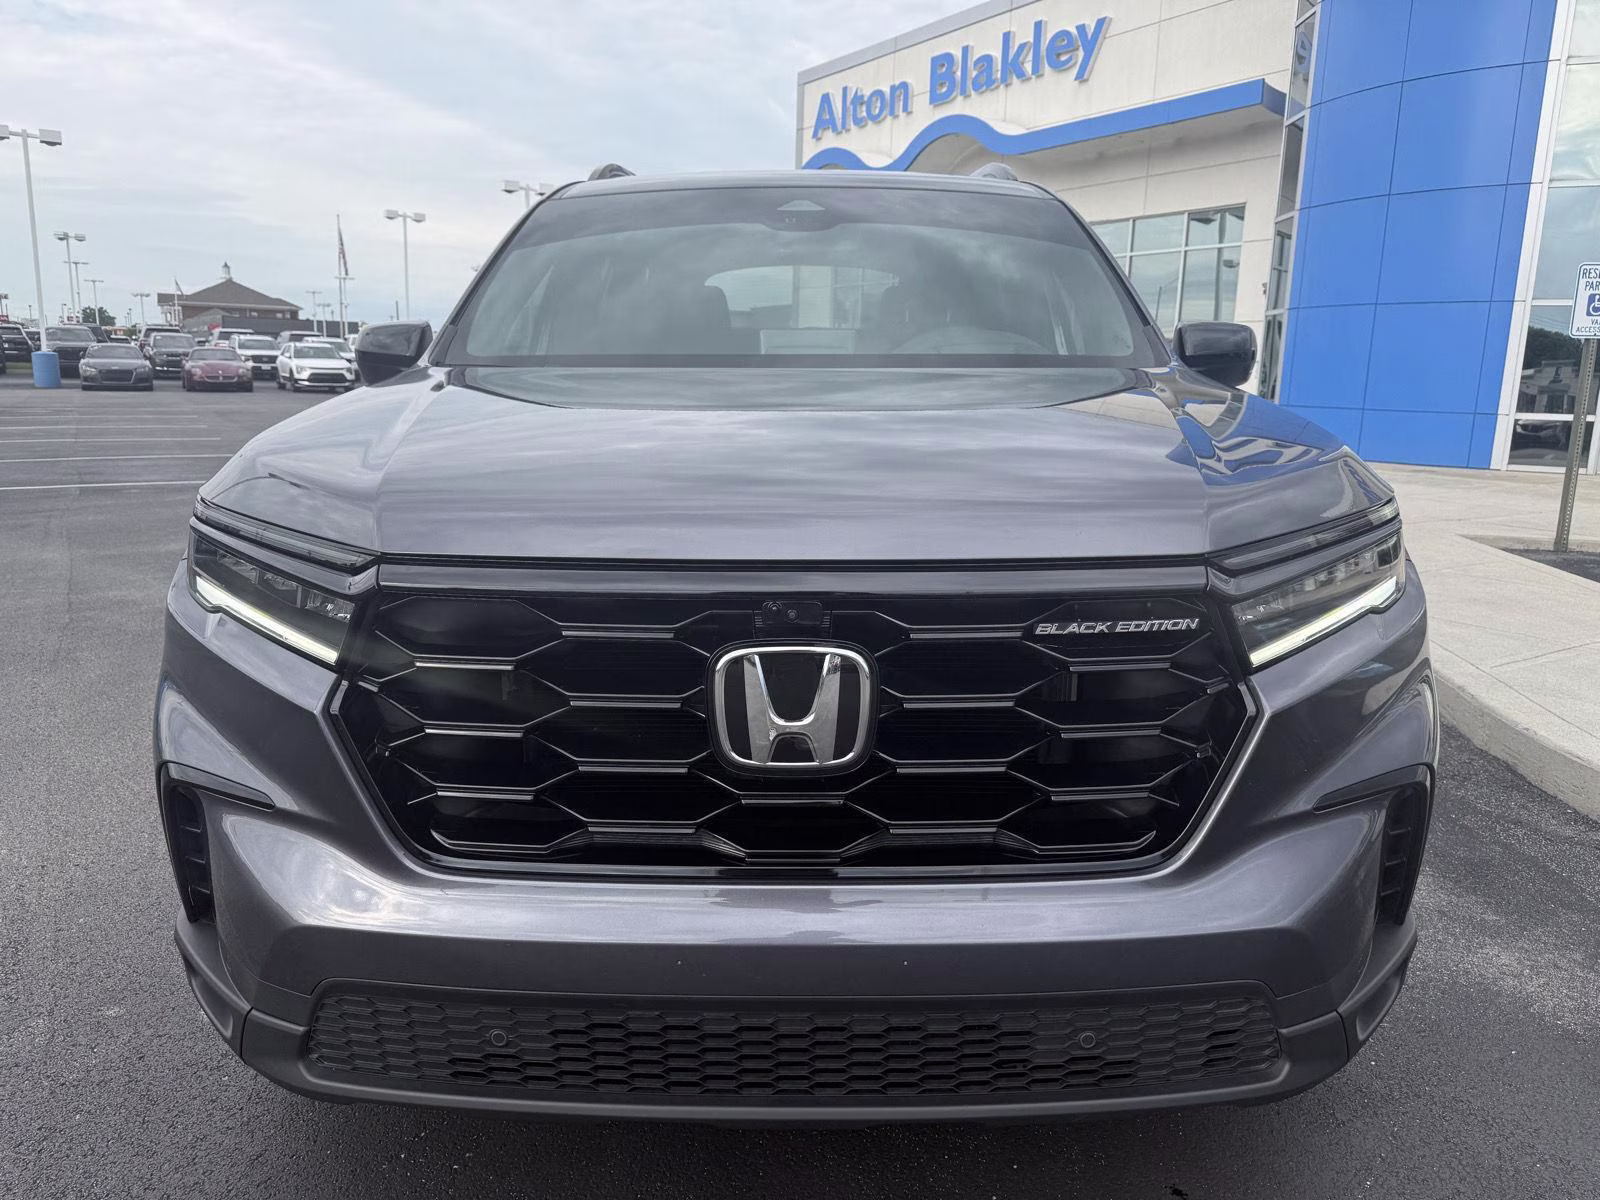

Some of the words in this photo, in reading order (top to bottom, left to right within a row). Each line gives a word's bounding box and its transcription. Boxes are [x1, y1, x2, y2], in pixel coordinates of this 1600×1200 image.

[811, 80, 912, 140] Alton
[928, 16, 1112, 105] Blakley
[1581, 267, 1600, 279] RES
[1035, 622, 1112, 635] BLACK
[1115, 618, 1199, 633] EDITION
